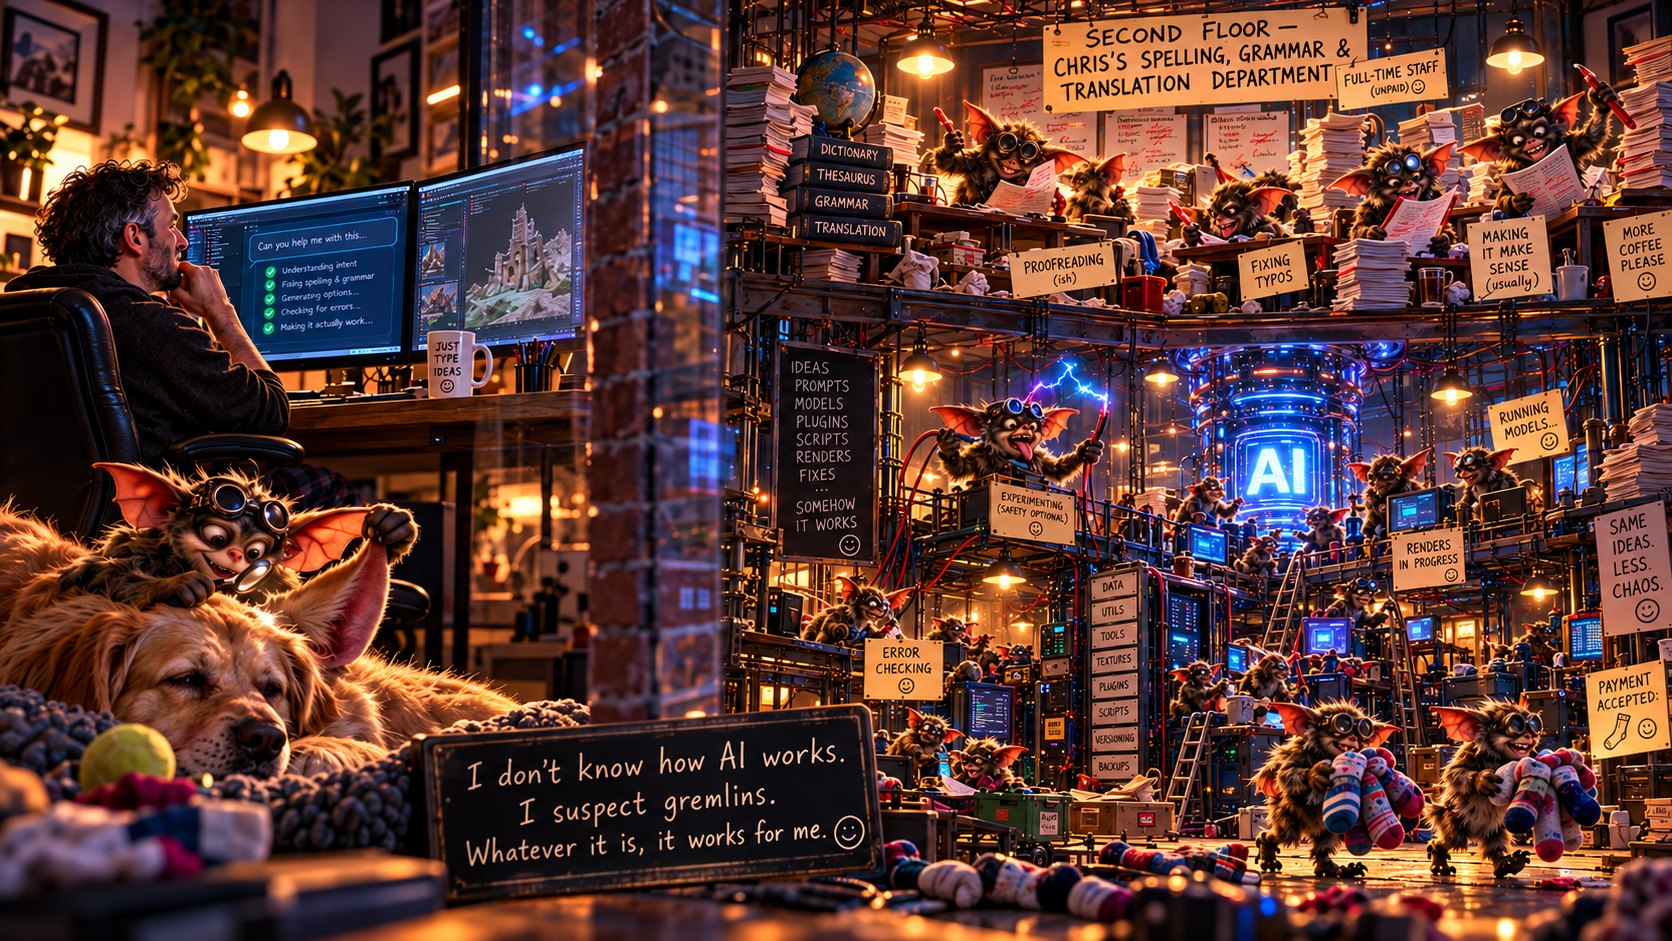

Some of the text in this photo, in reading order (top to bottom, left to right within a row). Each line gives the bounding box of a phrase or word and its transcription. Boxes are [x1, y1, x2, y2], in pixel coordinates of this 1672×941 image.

[1086, 25, 1182, 48] SECOND
[1203, 20, 1270, 40] FLOOR
[1054, 39, 1350, 77] CHRIS'S SPELLING, GRAMMAR &
[1343, 60, 1438, 87] FULL-TIME STAFF
[1060, 72, 1190, 102] TRANSLATION
[1212, 62, 1333, 90] DEPARTMENT
[1370, 82, 1409, 98] (UNPAID)
[821, 143, 879, 160] DICTIONARY
[817, 169, 875, 185] THESAURUS
[815, 195, 868, 209] GRAMMAR
[815, 222, 886, 236] TRANSLATION
[1483, 227, 1528, 244] MAKING
[1623, 223, 1655, 240] MORE
[257, 241, 273, 252] Can
[275, 241, 290, 252] you
[291, 236, 309, 249] help
[310, 237, 323, 245] me
[324, 232, 343, 243] with
[1620, 238, 1663, 257] COFFEE
[1483, 243, 1534, 260] IT MAKE
[281, 259, 358, 275] Understanding intent
[1024, 253, 1104, 275] PROOFREADING
[1251, 254, 1291, 273] FIXING
[1490, 259, 1528, 275] SENSE
[1620, 253, 1665, 272] PLEASE
[334, 275, 340, 284] &
[341, 273, 376, 285] grammar
[1054, 272, 1076, 287] (ish)
[1255, 270, 1293, 288] TYPOS
[1486, 272, 1539, 295] (usually)
[315, 304, 328, 313] for
[280, 322, 306, 333] Making
[307, 321, 314, 329] it
[314, 318, 344, 330] actually
[435, 341, 460, 352] JUST
[434, 353, 459, 364] TYPE
[433, 366, 462, 376] IDEAS
[792, 361, 829, 374] IDEAS
[796, 379, 849, 392] PROMPTS
[795, 397, 843, 410] MODELS
[1499, 401, 1549, 425] RUNNING
[797, 415, 848, 428] PLUGINS
[1505, 418, 1558, 440] MODELS...
[797, 433, 848, 446] SCRIPTS
[797, 450, 851, 463] RENDERS
[800, 468, 835, 482] FIXES
[1246, 448, 1305, 496] AI
[797, 497, 855, 514] SOMEHOW
[1001, 492, 1063, 510] EXPERIMENTING
[997, 504, 1068, 525] (SAFETY OPTIONAL)
[797, 516, 857, 531] IT WORKS
[1610, 513, 1647, 536] SAME
[1407, 539, 1451, 554] RENDERS
[1612, 535, 1654, 555] IDEAS.
[1399, 554, 1458, 570] IN PROGRESS
[1614, 556, 1652, 577] LESS.
[1103, 580, 1123, 592] DATA
[1613, 576, 1663, 599] CHAOS.
[1102, 605, 1124, 617] UTILS
[1101, 630, 1125, 641] TOOLS
[883, 647, 920, 658] ERROR
[1096, 654, 1132, 667] TEXTURES
[876, 663, 931, 674] CHECKING
[1100, 680, 1129, 691] PLUGINS
[1598, 672, 1652, 695] PAYMENT
[1598, 691, 1659, 712] ACCEPTED:
[1099, 706, 1129, 717] SCRIPTS
[1095, 731, 1135, 744] VERSIONING
[468, 737, 844, 790] I don't know how AI works.
[520, 783, 775, 827] I suspect gremlins.
[466, 819, 826, 866] Whatever it is, it works for me.
